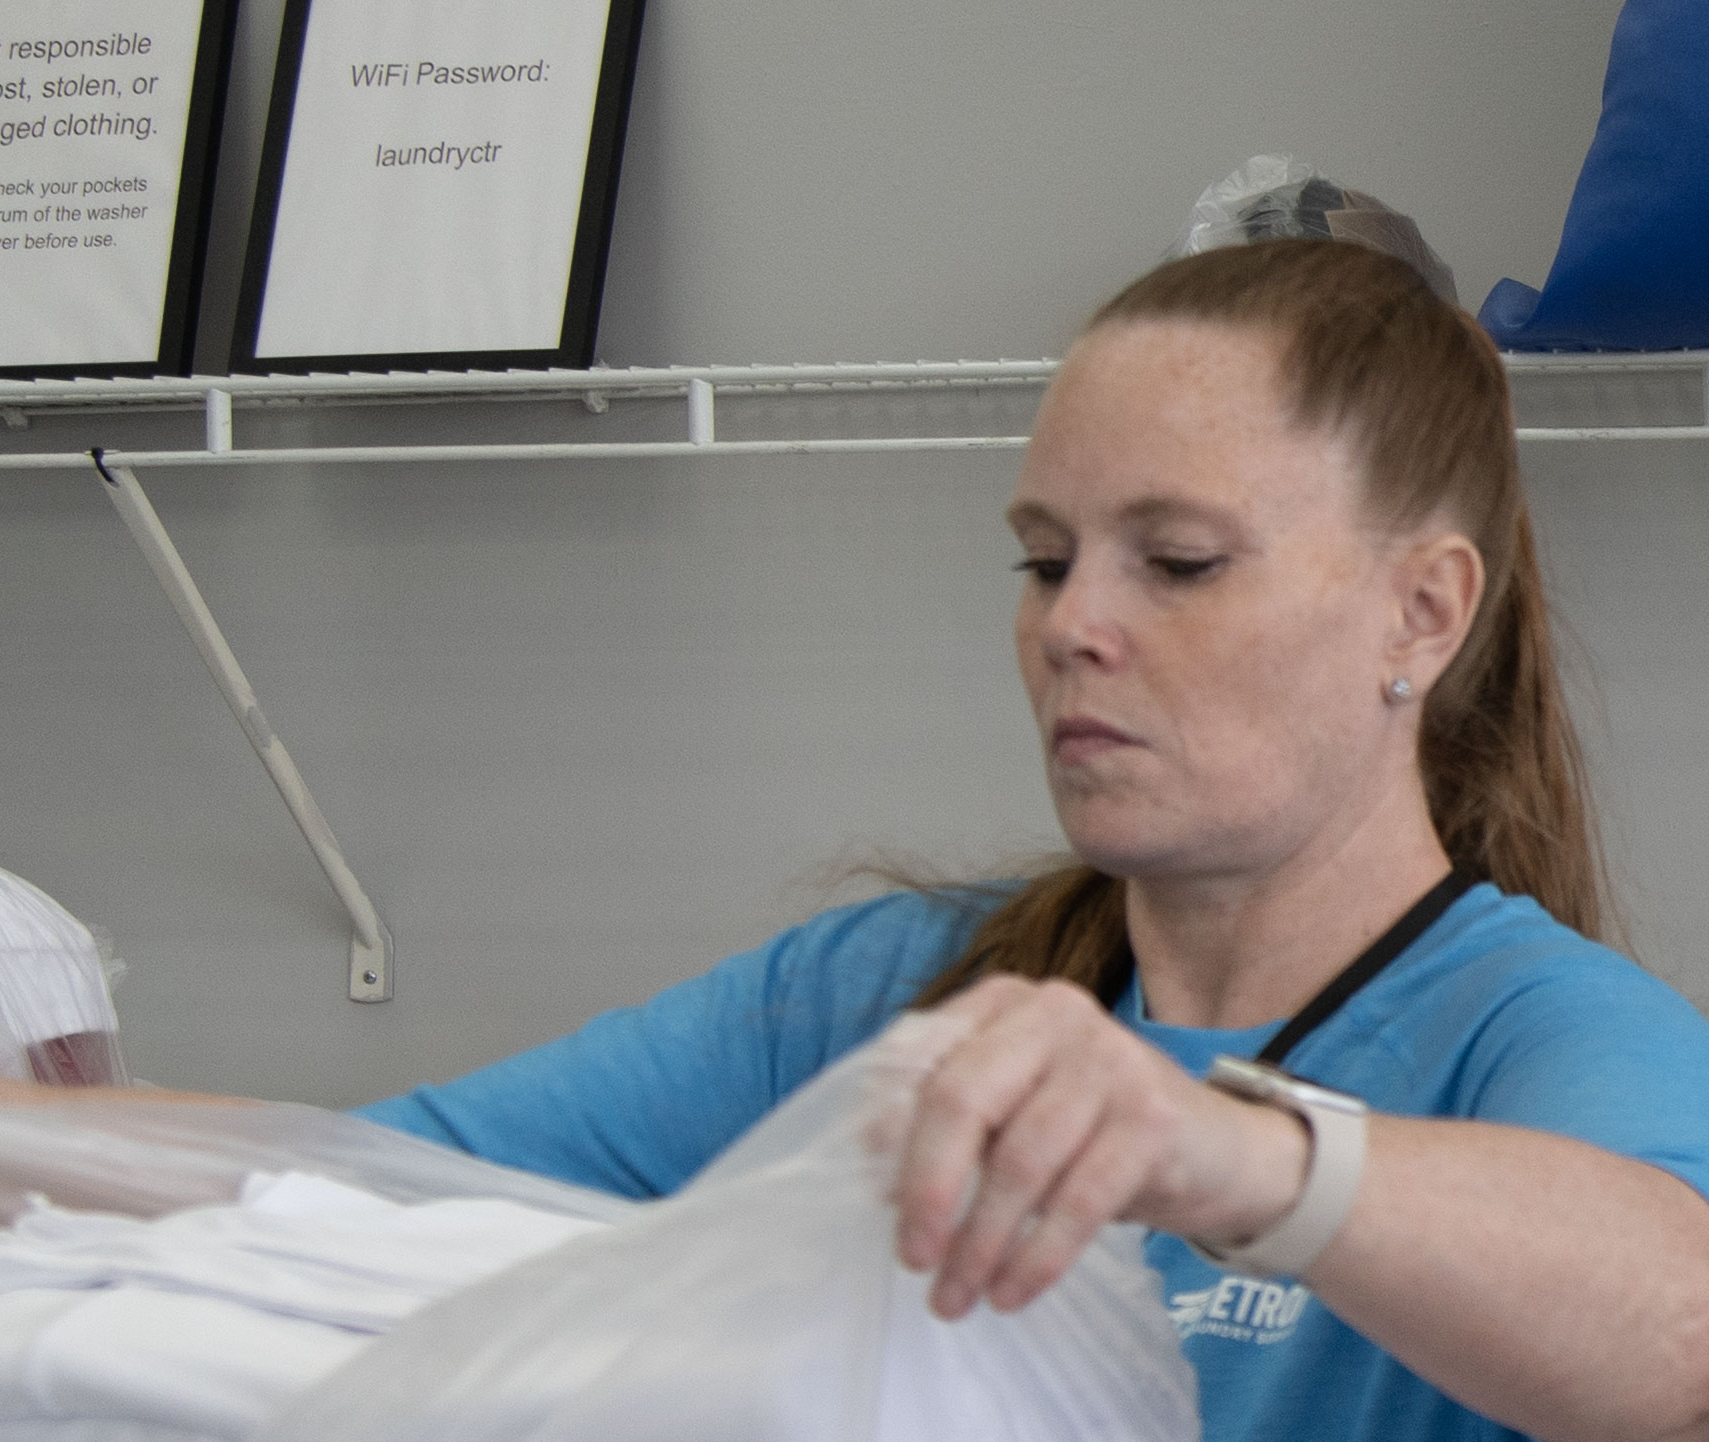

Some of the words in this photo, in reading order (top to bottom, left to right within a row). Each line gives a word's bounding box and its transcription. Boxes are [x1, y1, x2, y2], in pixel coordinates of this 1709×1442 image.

[8, 32, 153, 64] responsible
[351, 64, 409, 87] WiFi
[416, 59, 551, 85] Password:
[42, 74, 122, 99] stolen,
[132, 76, 159, 95] or
[53, 112, 158, 141] clothing.
[375, 141, 503, 170] laundryctr
[40, 180, 79, 199] your
[82, 176, 148, 197] pockets
[33, 206, 52, 222] of
[56, 206, 81, 221] the
[86, 204, 148, 221] washer
[24, 233, 79, 249] before
[83, 234, 118, 247] use.
